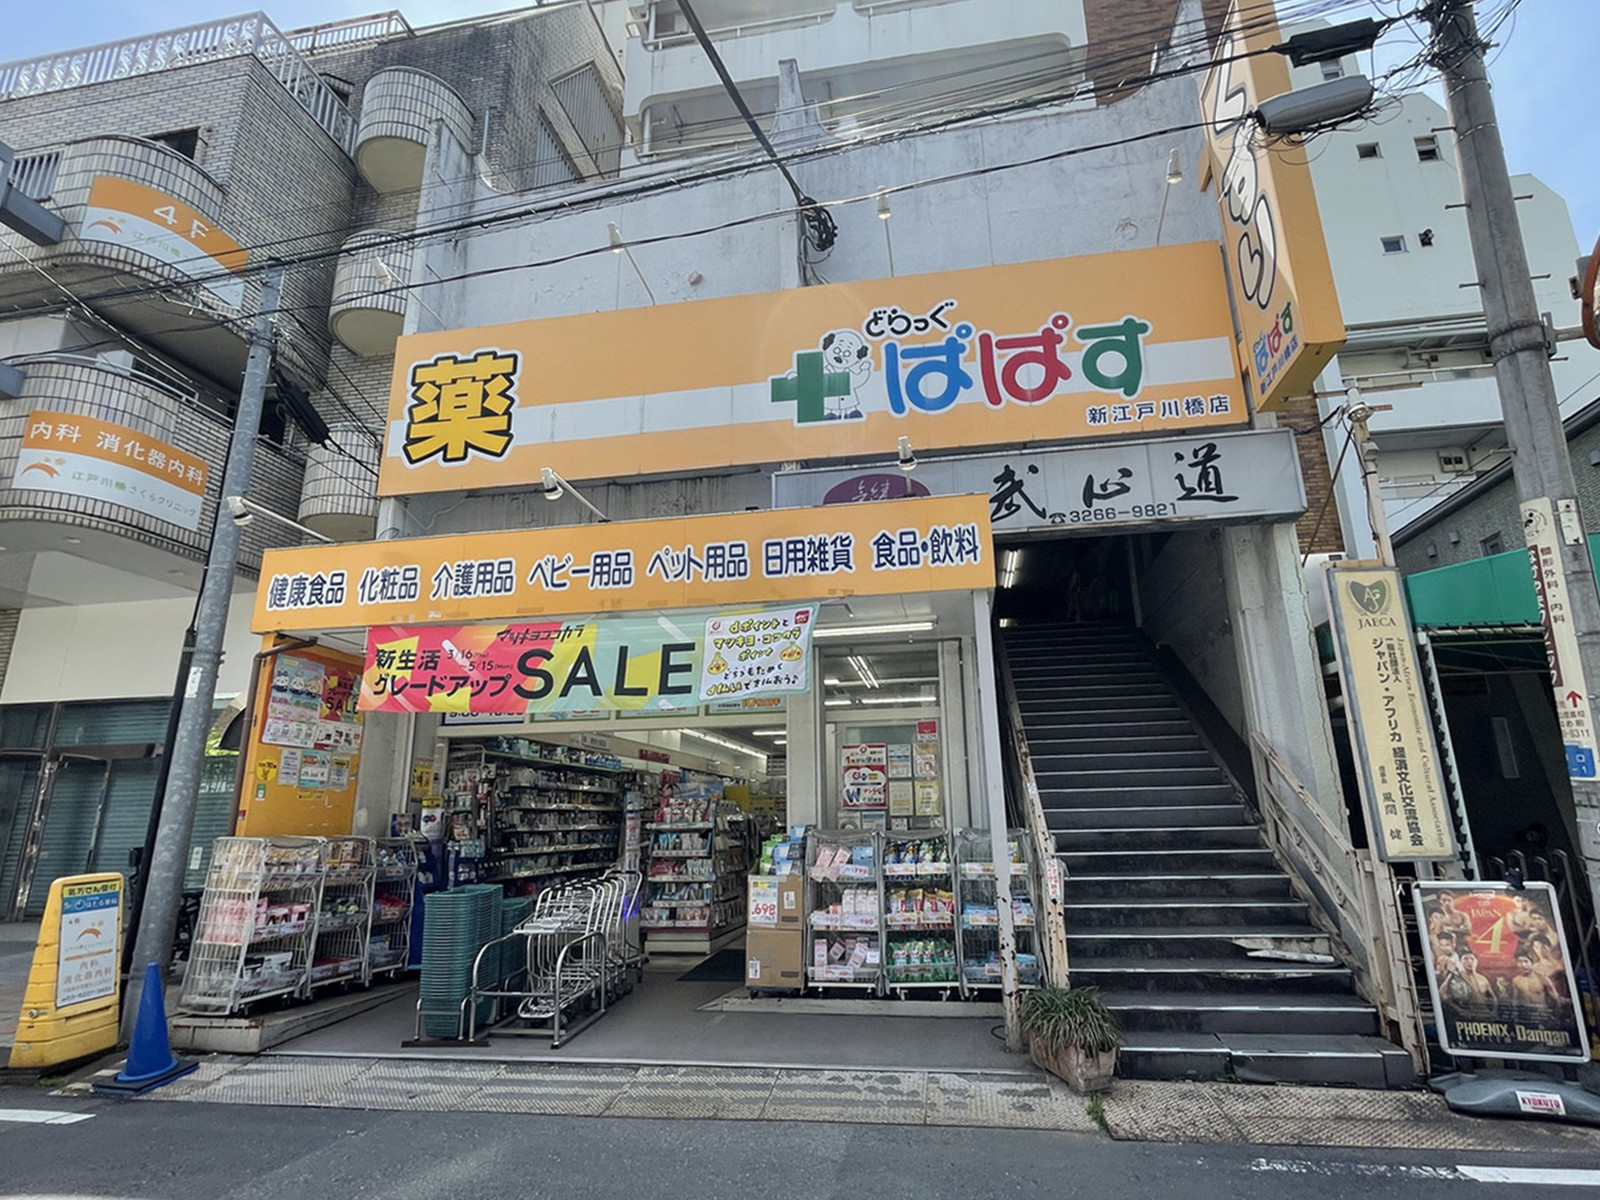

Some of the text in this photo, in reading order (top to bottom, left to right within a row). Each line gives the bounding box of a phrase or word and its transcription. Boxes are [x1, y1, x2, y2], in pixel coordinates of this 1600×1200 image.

[865, 301, 955, 337] どらっぐ
[884, 314, 1150, 414] ぱぱす
[404, 351, 519, 464] 薬
[1087, 397, 1231, 425] 新江戸川橋店
[30, 422, 204, 487] 内科 消化器内科
[1070, 503, 1178, 523] 3266-9821
[268, 526, 980, 609] 健康食品 化粧品 介護用品 ベビー用品 ペット用品 日用雑貨 食品・飲料
[1358, 618, 1397, 629] JAECA
[376, 649, 441, 671] 新生活
[513, 642, 696, 700] SALE
[373, 673, 513, 697] グレードアップ
[1372, 638, 1402, 743] ジャパン・アフリカ
[1408, 693, 1422, 735] Economic
[1420, 755, 1435, 793] Cultural
[68, 884, 117, 896] 処方せん受付
[754, 903, 777, 916] 698
[1475, 915, 1508, 954] 4
[1455, 1021, 1510, 1038] PHOENIX
[1514, 1024, 1571, 1046] Dangan
